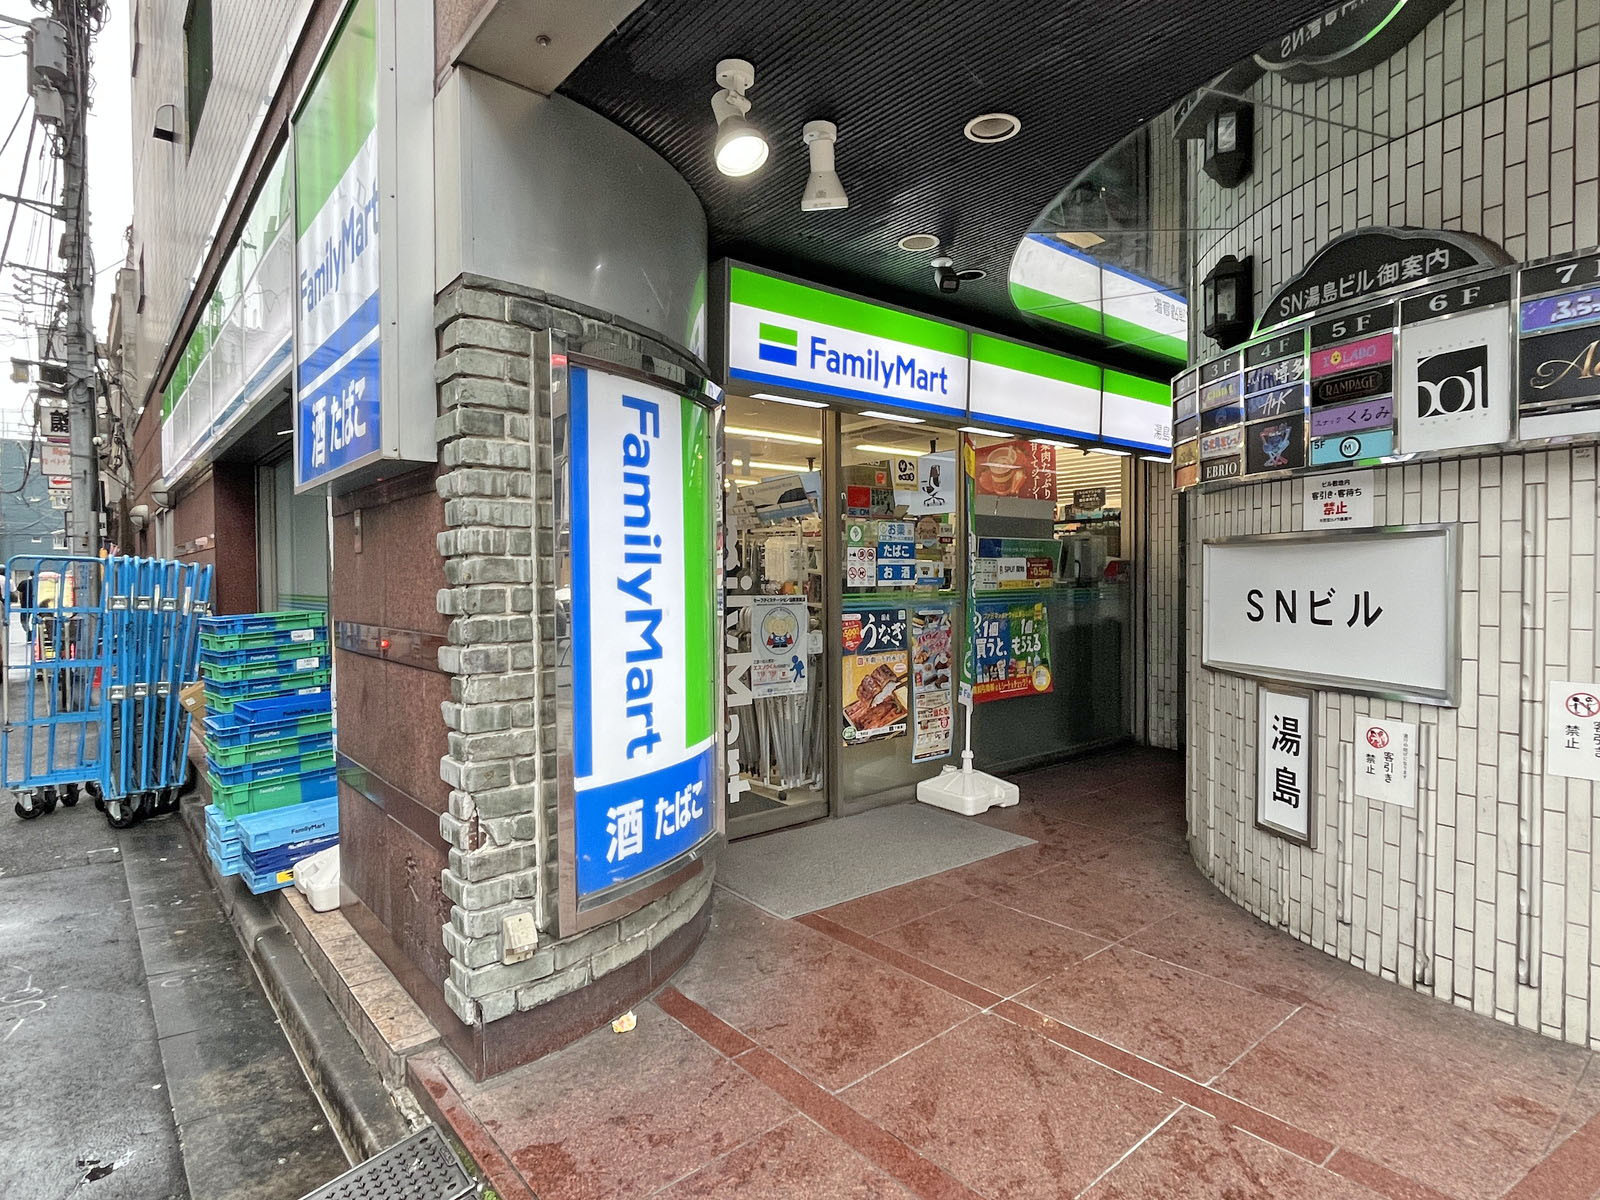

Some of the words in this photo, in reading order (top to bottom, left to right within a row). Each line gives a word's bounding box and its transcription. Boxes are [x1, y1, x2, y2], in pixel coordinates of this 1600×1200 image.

[300, 182, 379, 320] FamilyMart
[810, 335, 948, 396] FamilyMart
[1325, 375, 1376, 397] RAMPAGE
[311, 395, 327, 469] 酒
[330, 377, 367, 453] たばこ
[1347, 406, 1391, 424] くるみ
[1206, 462, 1238, 479] EBRIO
[1311, 487, 1362, 501] 客引き・客待ち
[1323, 500, 1348, 516] 禁止
[883, 544, 910, 557] たばこ
[617, 394, 664, 760] FamilyMart
[883, 566, 911, 580] お酒
[1246, 587, 1383, 629] SNビル
[861, 613, 906, 651] うなぎ
[1564, 724, 1580, 749] 禁止
[1271, 714, 1301, 809] 湯島
[1365, 753, 1376, 775] 禁止
[1383, 751, 1395, 784] 客引き
[291, 823, 326, 835] FamilyMart
[606, 799, 644, 864] 酒
[655, 780, 704, 840] たばこ
